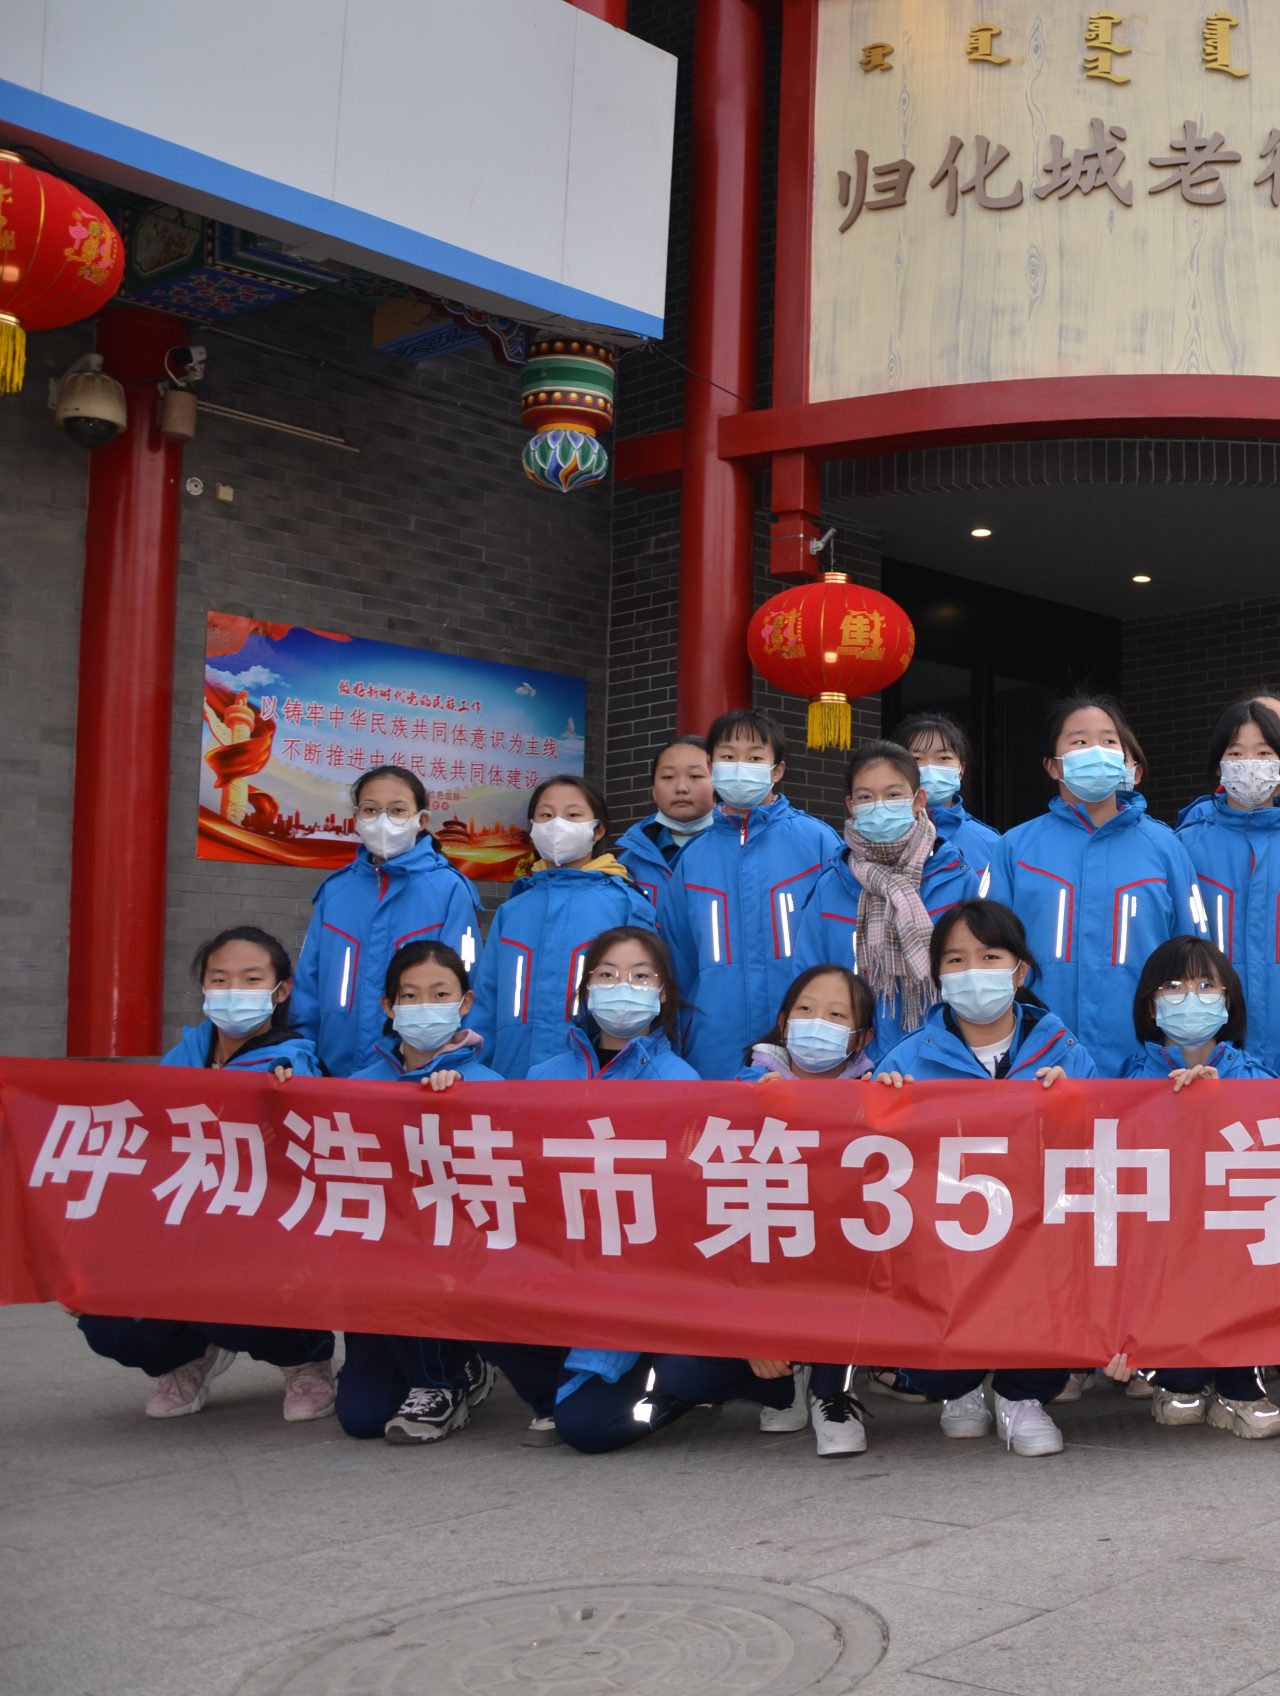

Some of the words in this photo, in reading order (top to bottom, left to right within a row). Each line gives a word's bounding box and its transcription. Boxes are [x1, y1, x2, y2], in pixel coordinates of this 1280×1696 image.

[338, 679, 483, 714] 做好新时代党的民族工作
[260, 694, 560, 760] 以铸牢中华民族共同体意识为主线
[280, 737, 541, 791] 不断推进中华民族共同体建设
